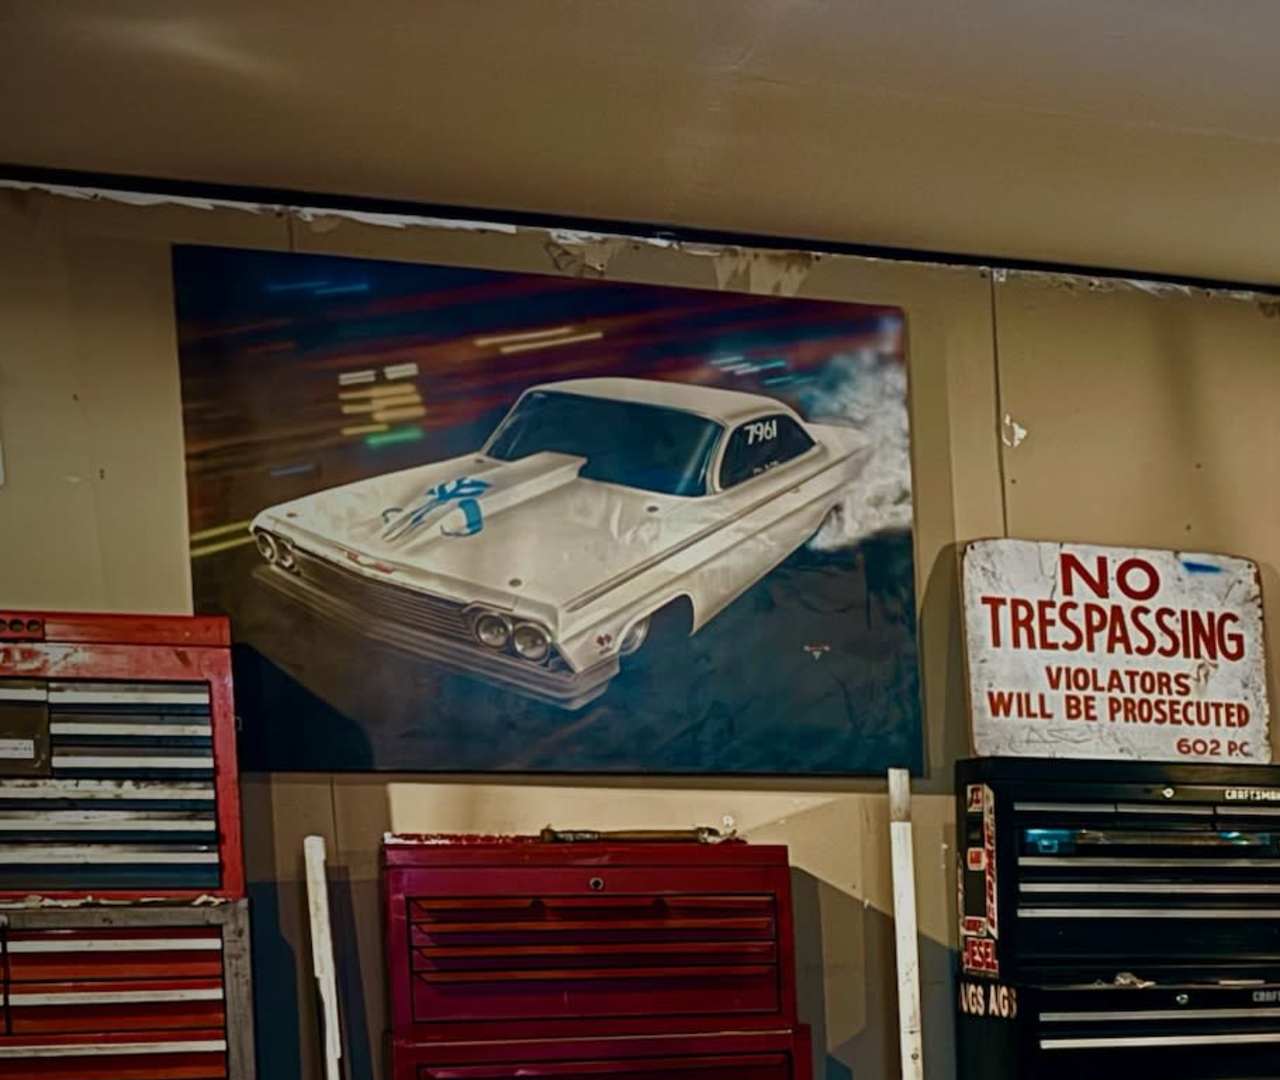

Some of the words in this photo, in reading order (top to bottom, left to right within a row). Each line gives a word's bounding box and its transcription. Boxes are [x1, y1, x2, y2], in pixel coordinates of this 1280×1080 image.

[743, 418, 777, 446] 7961
[1060, 553, 1160, 601] NO
[981, 596, 1245, 662] TRESPASSING
[1045, 665, 1191, 697] VIOLATORS
[988, 691, 1053, 720] WILL
[1065, 695, 1097, 722] BE
[1108, 697, 1250, 728] PROSECUTED
[1176, 738, 1221, 757] 602
